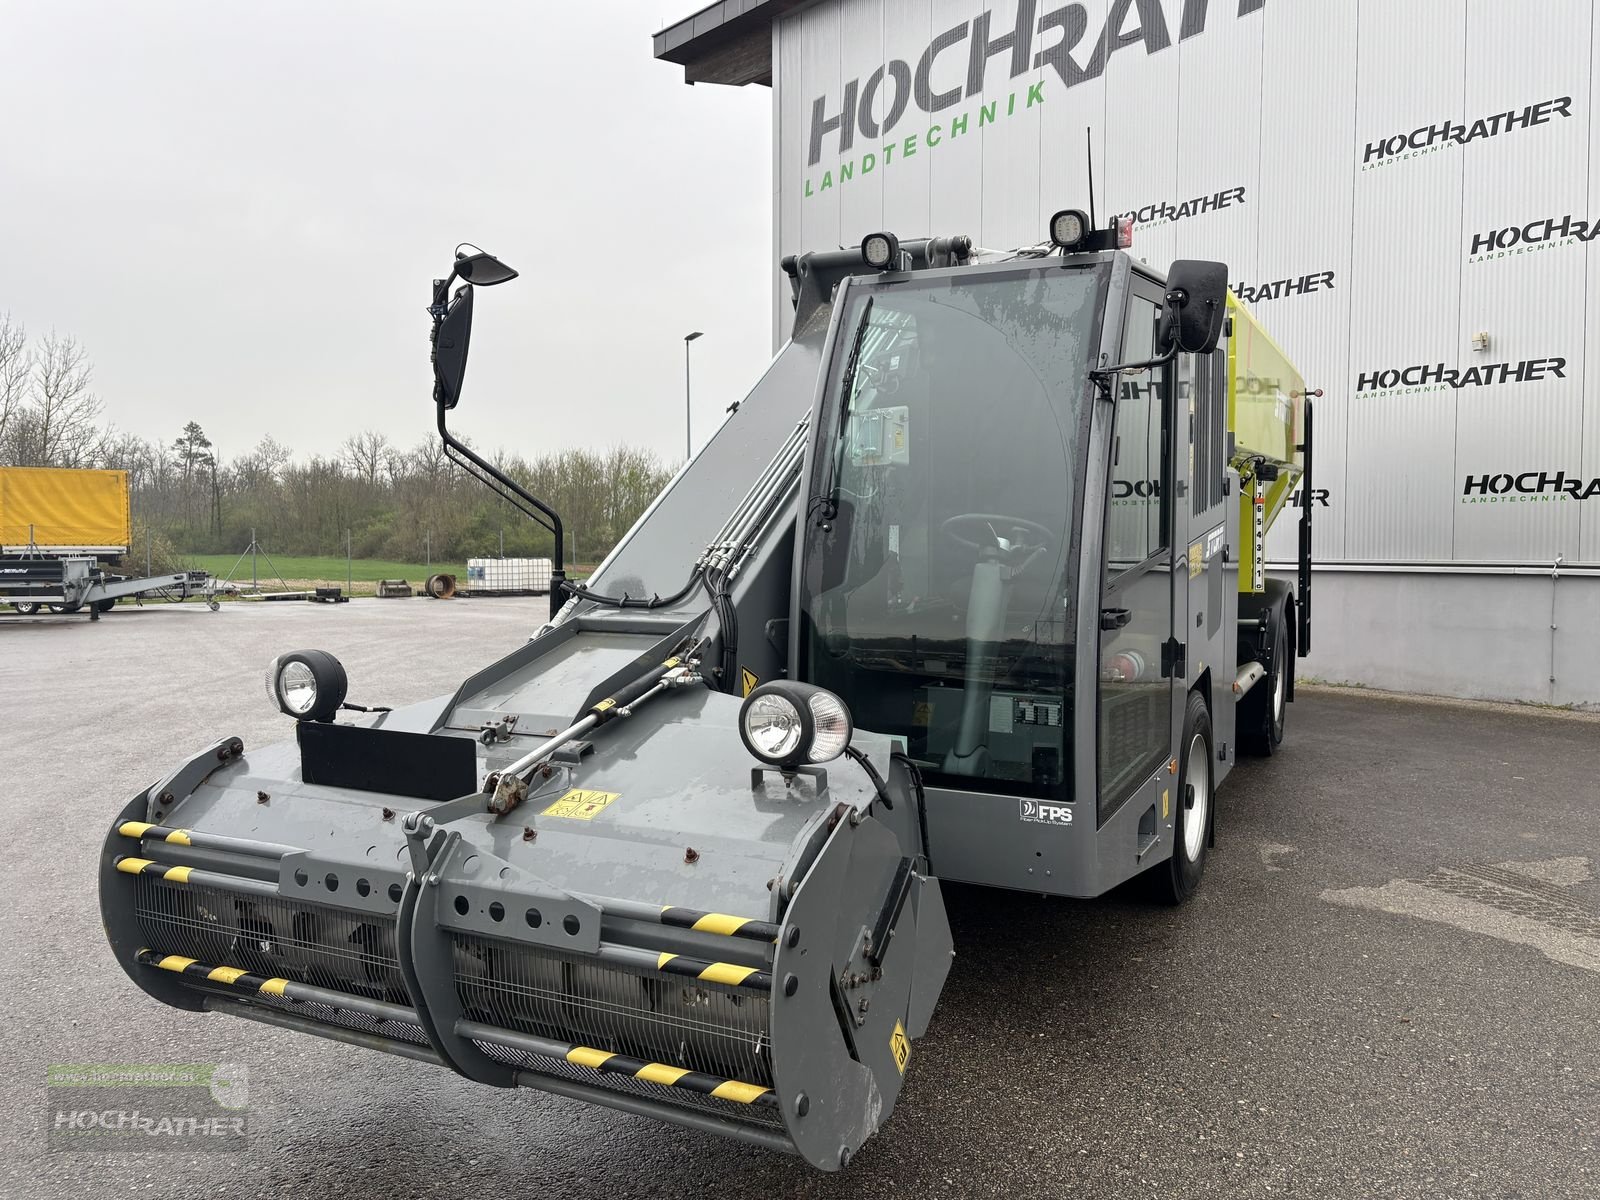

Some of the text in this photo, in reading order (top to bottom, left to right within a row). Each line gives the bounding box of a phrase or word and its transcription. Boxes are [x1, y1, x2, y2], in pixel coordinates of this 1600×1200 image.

[807, 0, 1265, 168] HOCHRA
[803, 80, 1046, 198] LANDTECHNIK
[1362, 96, 1572, 164] HOCHRATHER
[1361, 141, 1454, 172] LANDTECHNIK
[1468, 238, 1575, 264] LANDTECHNIK
[1228, 271, 1335, 304] HRATHER
[1356, 357, 1567, 392] HOCHRATHER
[1355, 384, 1448, 400] LANDTECHNIK
[1461, 494, 1568, 504] LANDTECHNIK
[1039, 805, 1073, 822] FPS
